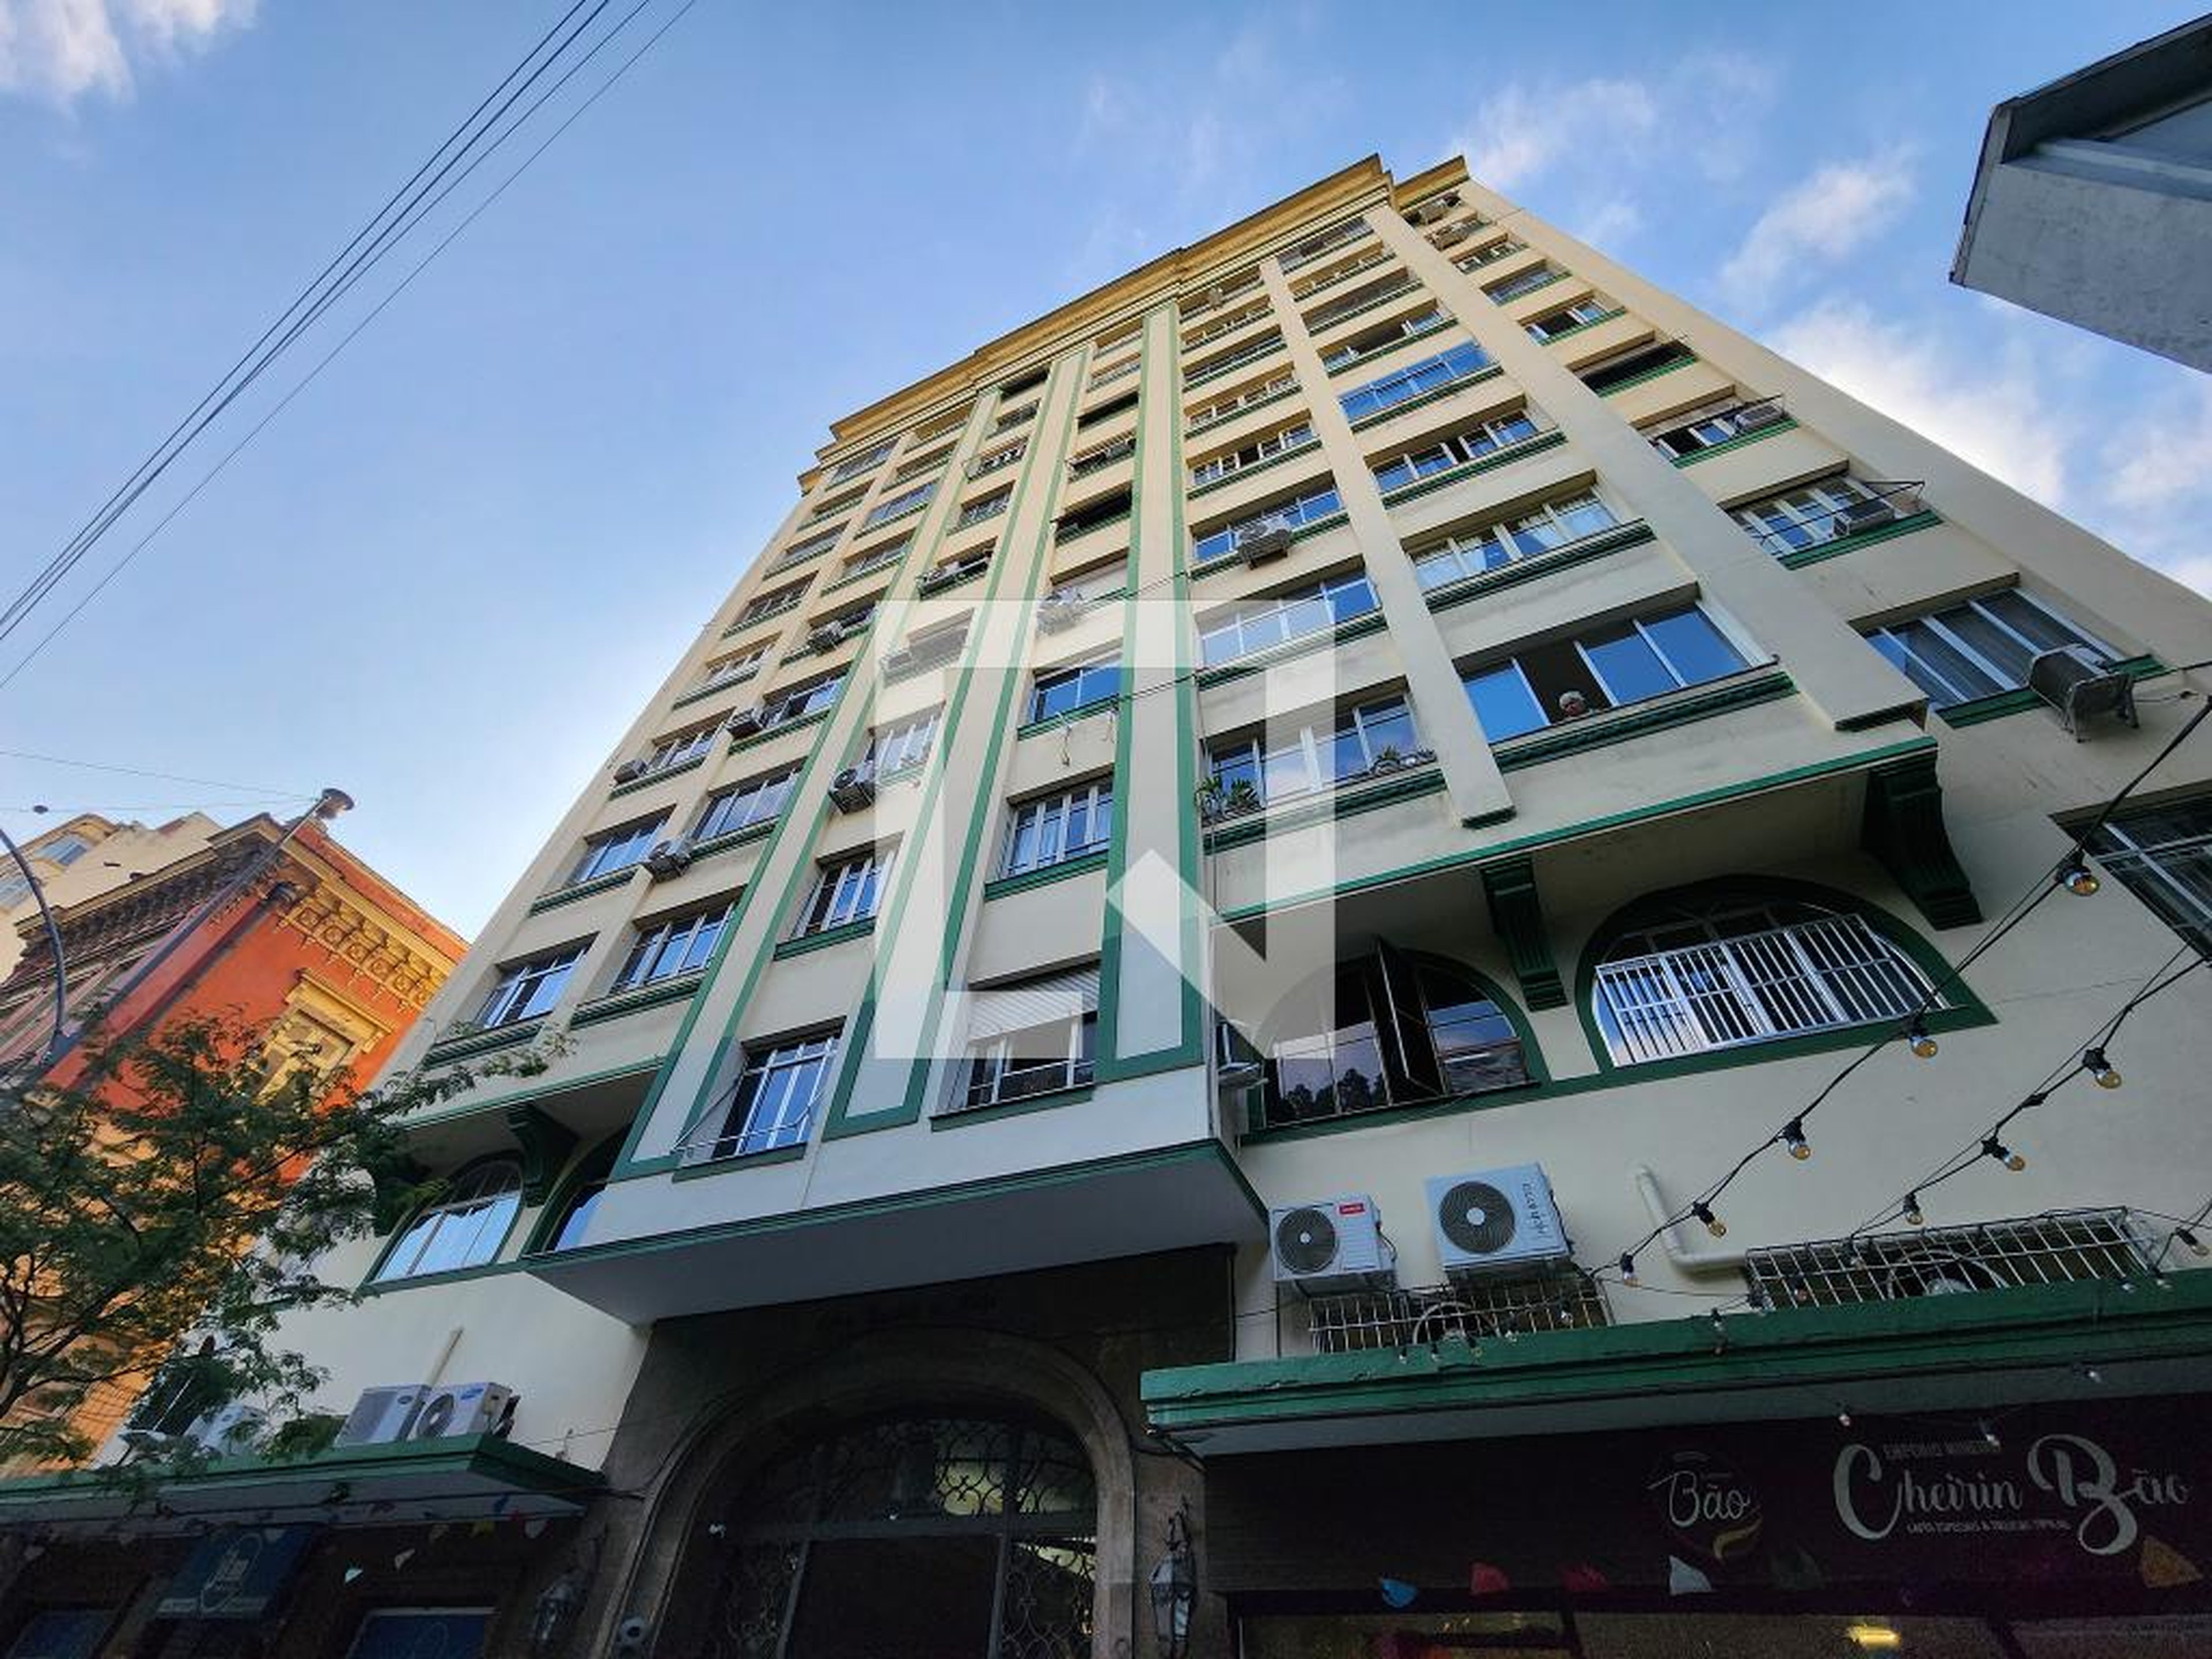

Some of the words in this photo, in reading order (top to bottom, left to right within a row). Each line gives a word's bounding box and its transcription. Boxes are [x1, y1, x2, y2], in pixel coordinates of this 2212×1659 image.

[1646, 1469, 1752, 1528] Bão
[1833, 1444, 2023, 1540] Cheirin
[2027, 1433, 2192, 1555] Bão
